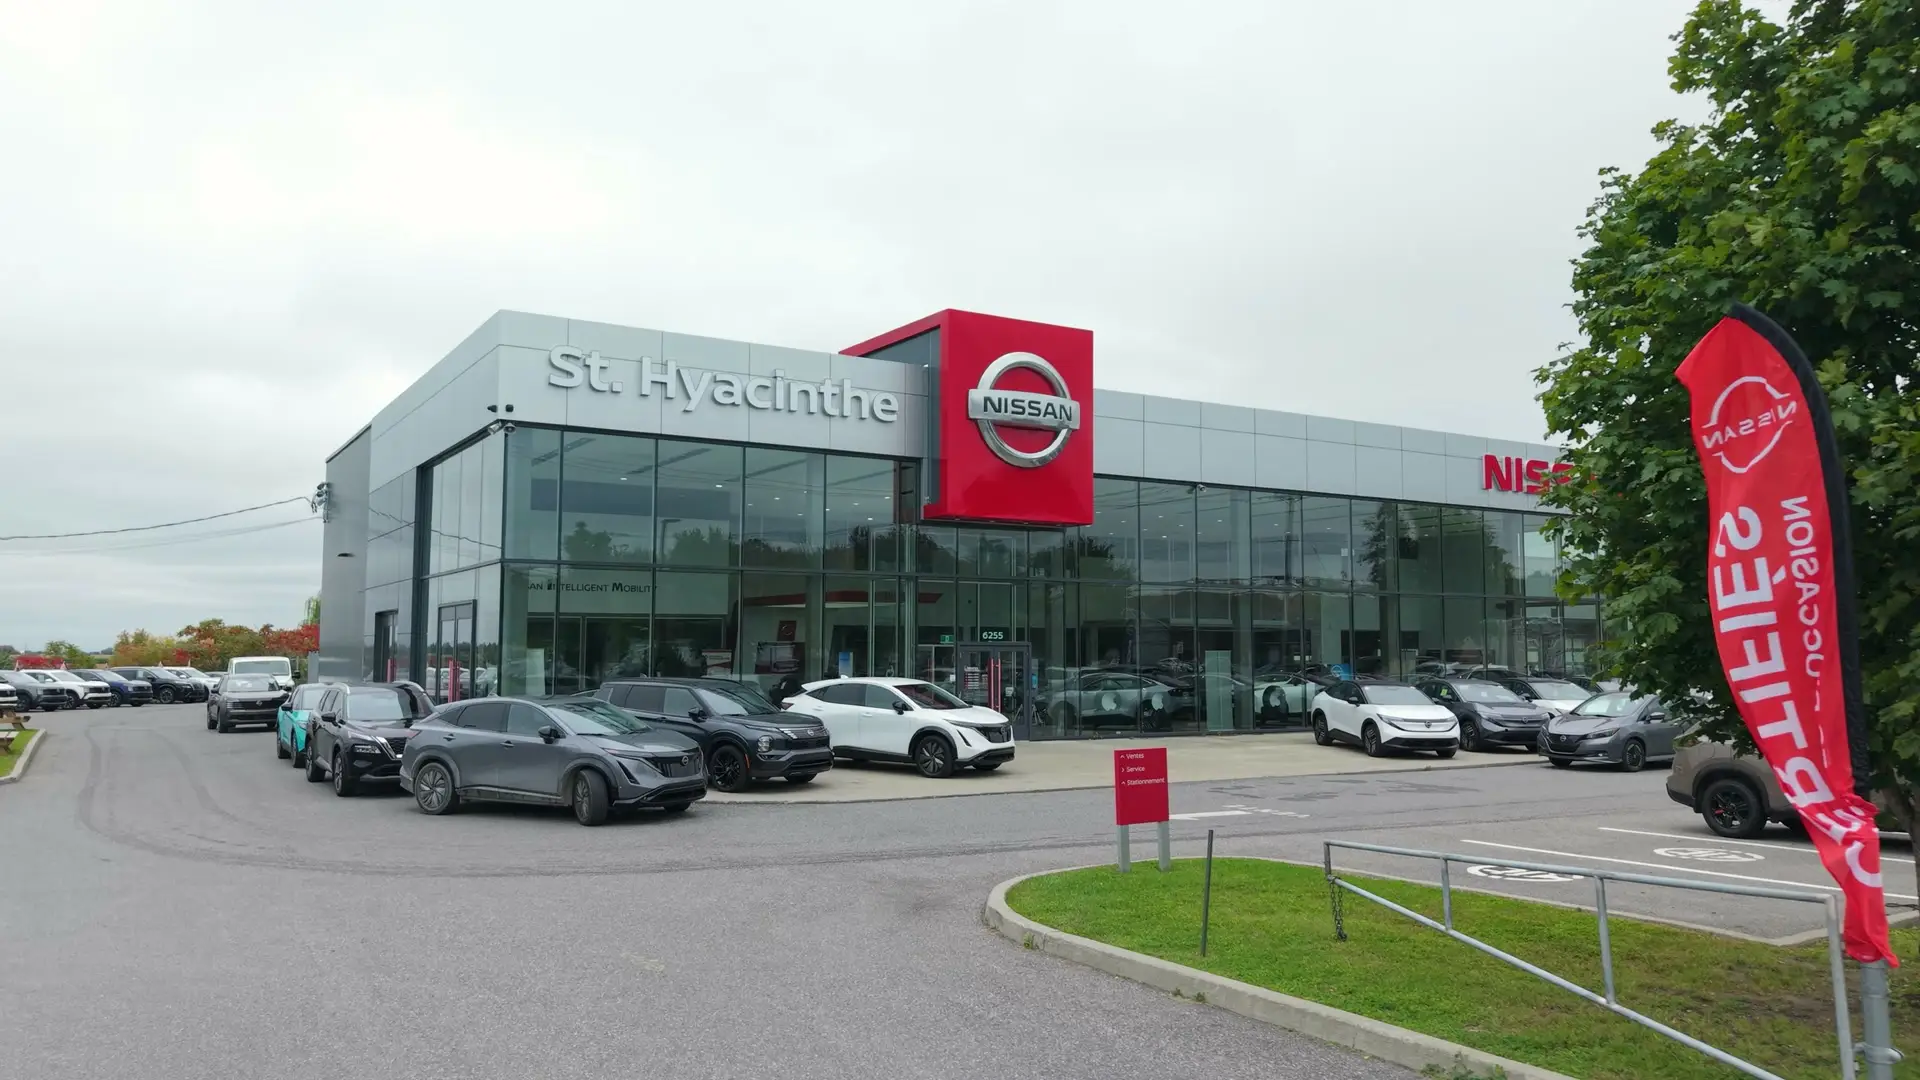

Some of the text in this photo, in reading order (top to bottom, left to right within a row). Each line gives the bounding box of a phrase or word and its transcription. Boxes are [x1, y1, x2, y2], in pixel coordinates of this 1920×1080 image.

[549, 345, 899, 422] St. Hyacinthe
[983, 396, 1072, 421] NISSAN
[982, 631, 1003, 640] 6255
[1127, 778, 1165, 786] Stationnement
